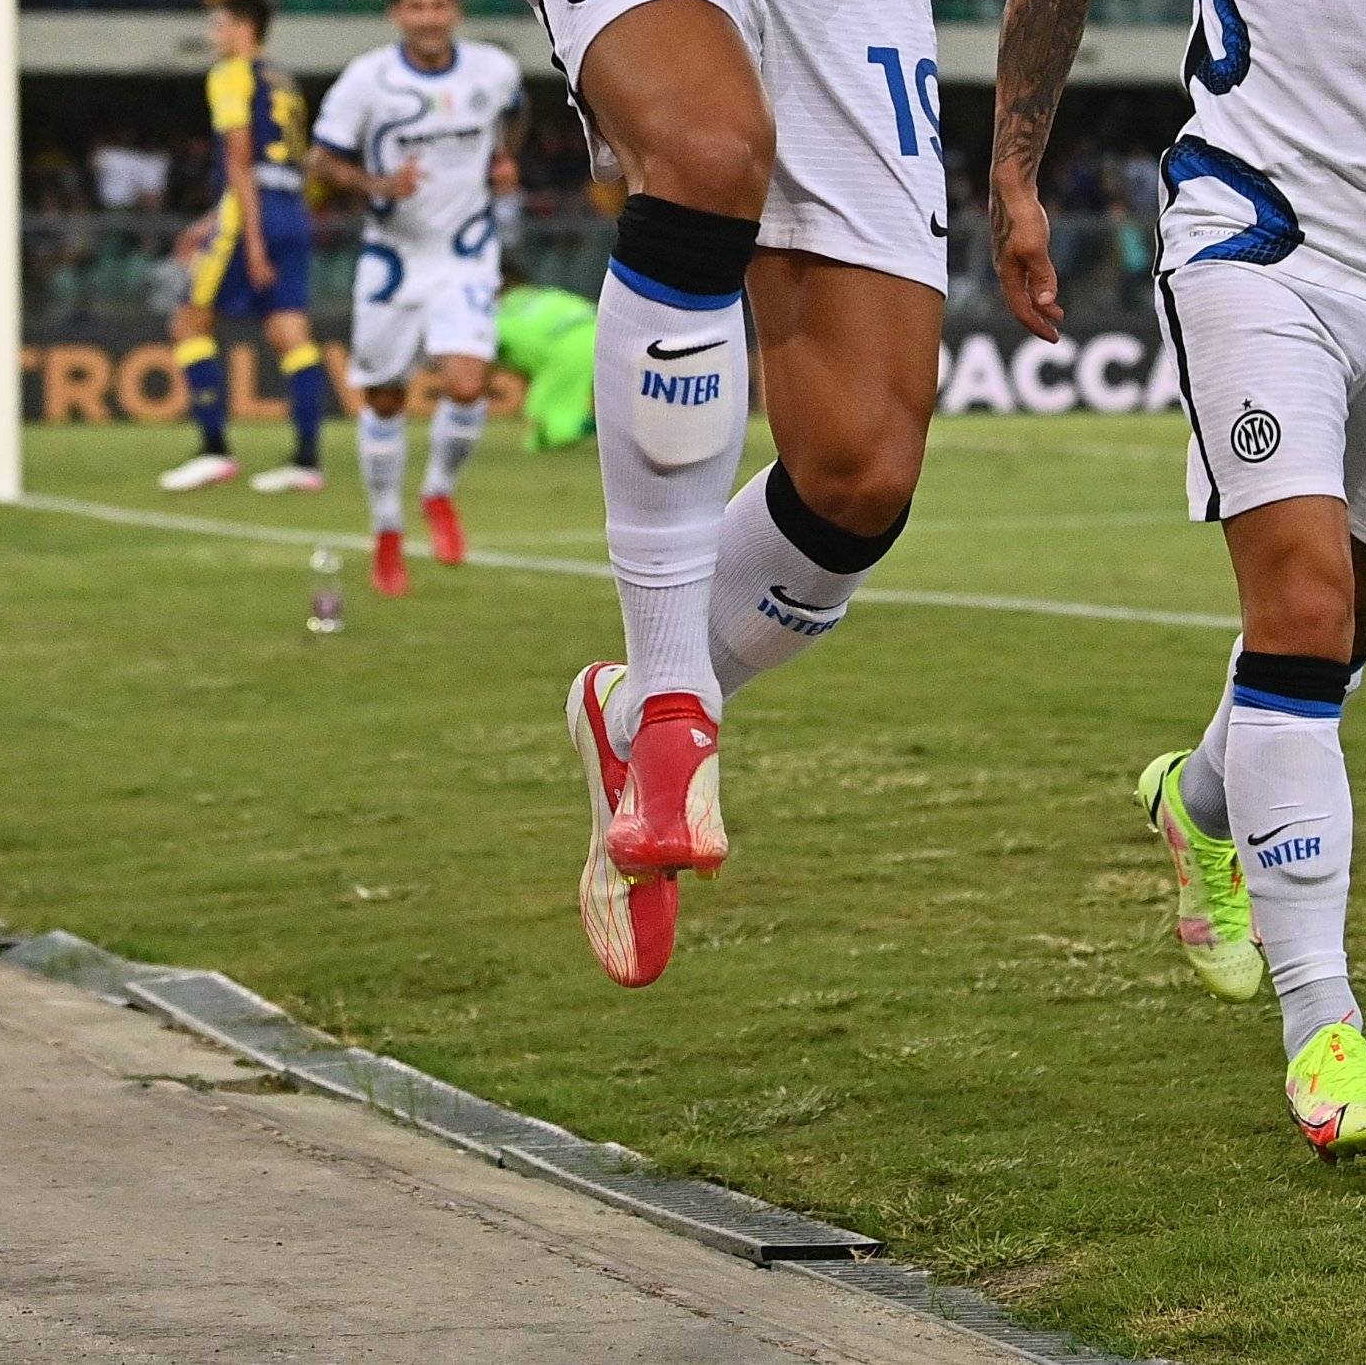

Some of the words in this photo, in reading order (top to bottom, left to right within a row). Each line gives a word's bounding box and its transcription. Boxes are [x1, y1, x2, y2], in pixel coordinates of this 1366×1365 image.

[641, 370, 721, 406] INTER
[756, 597, 841, 637] INTER
[1257, 836, 1321, 869] INTER
